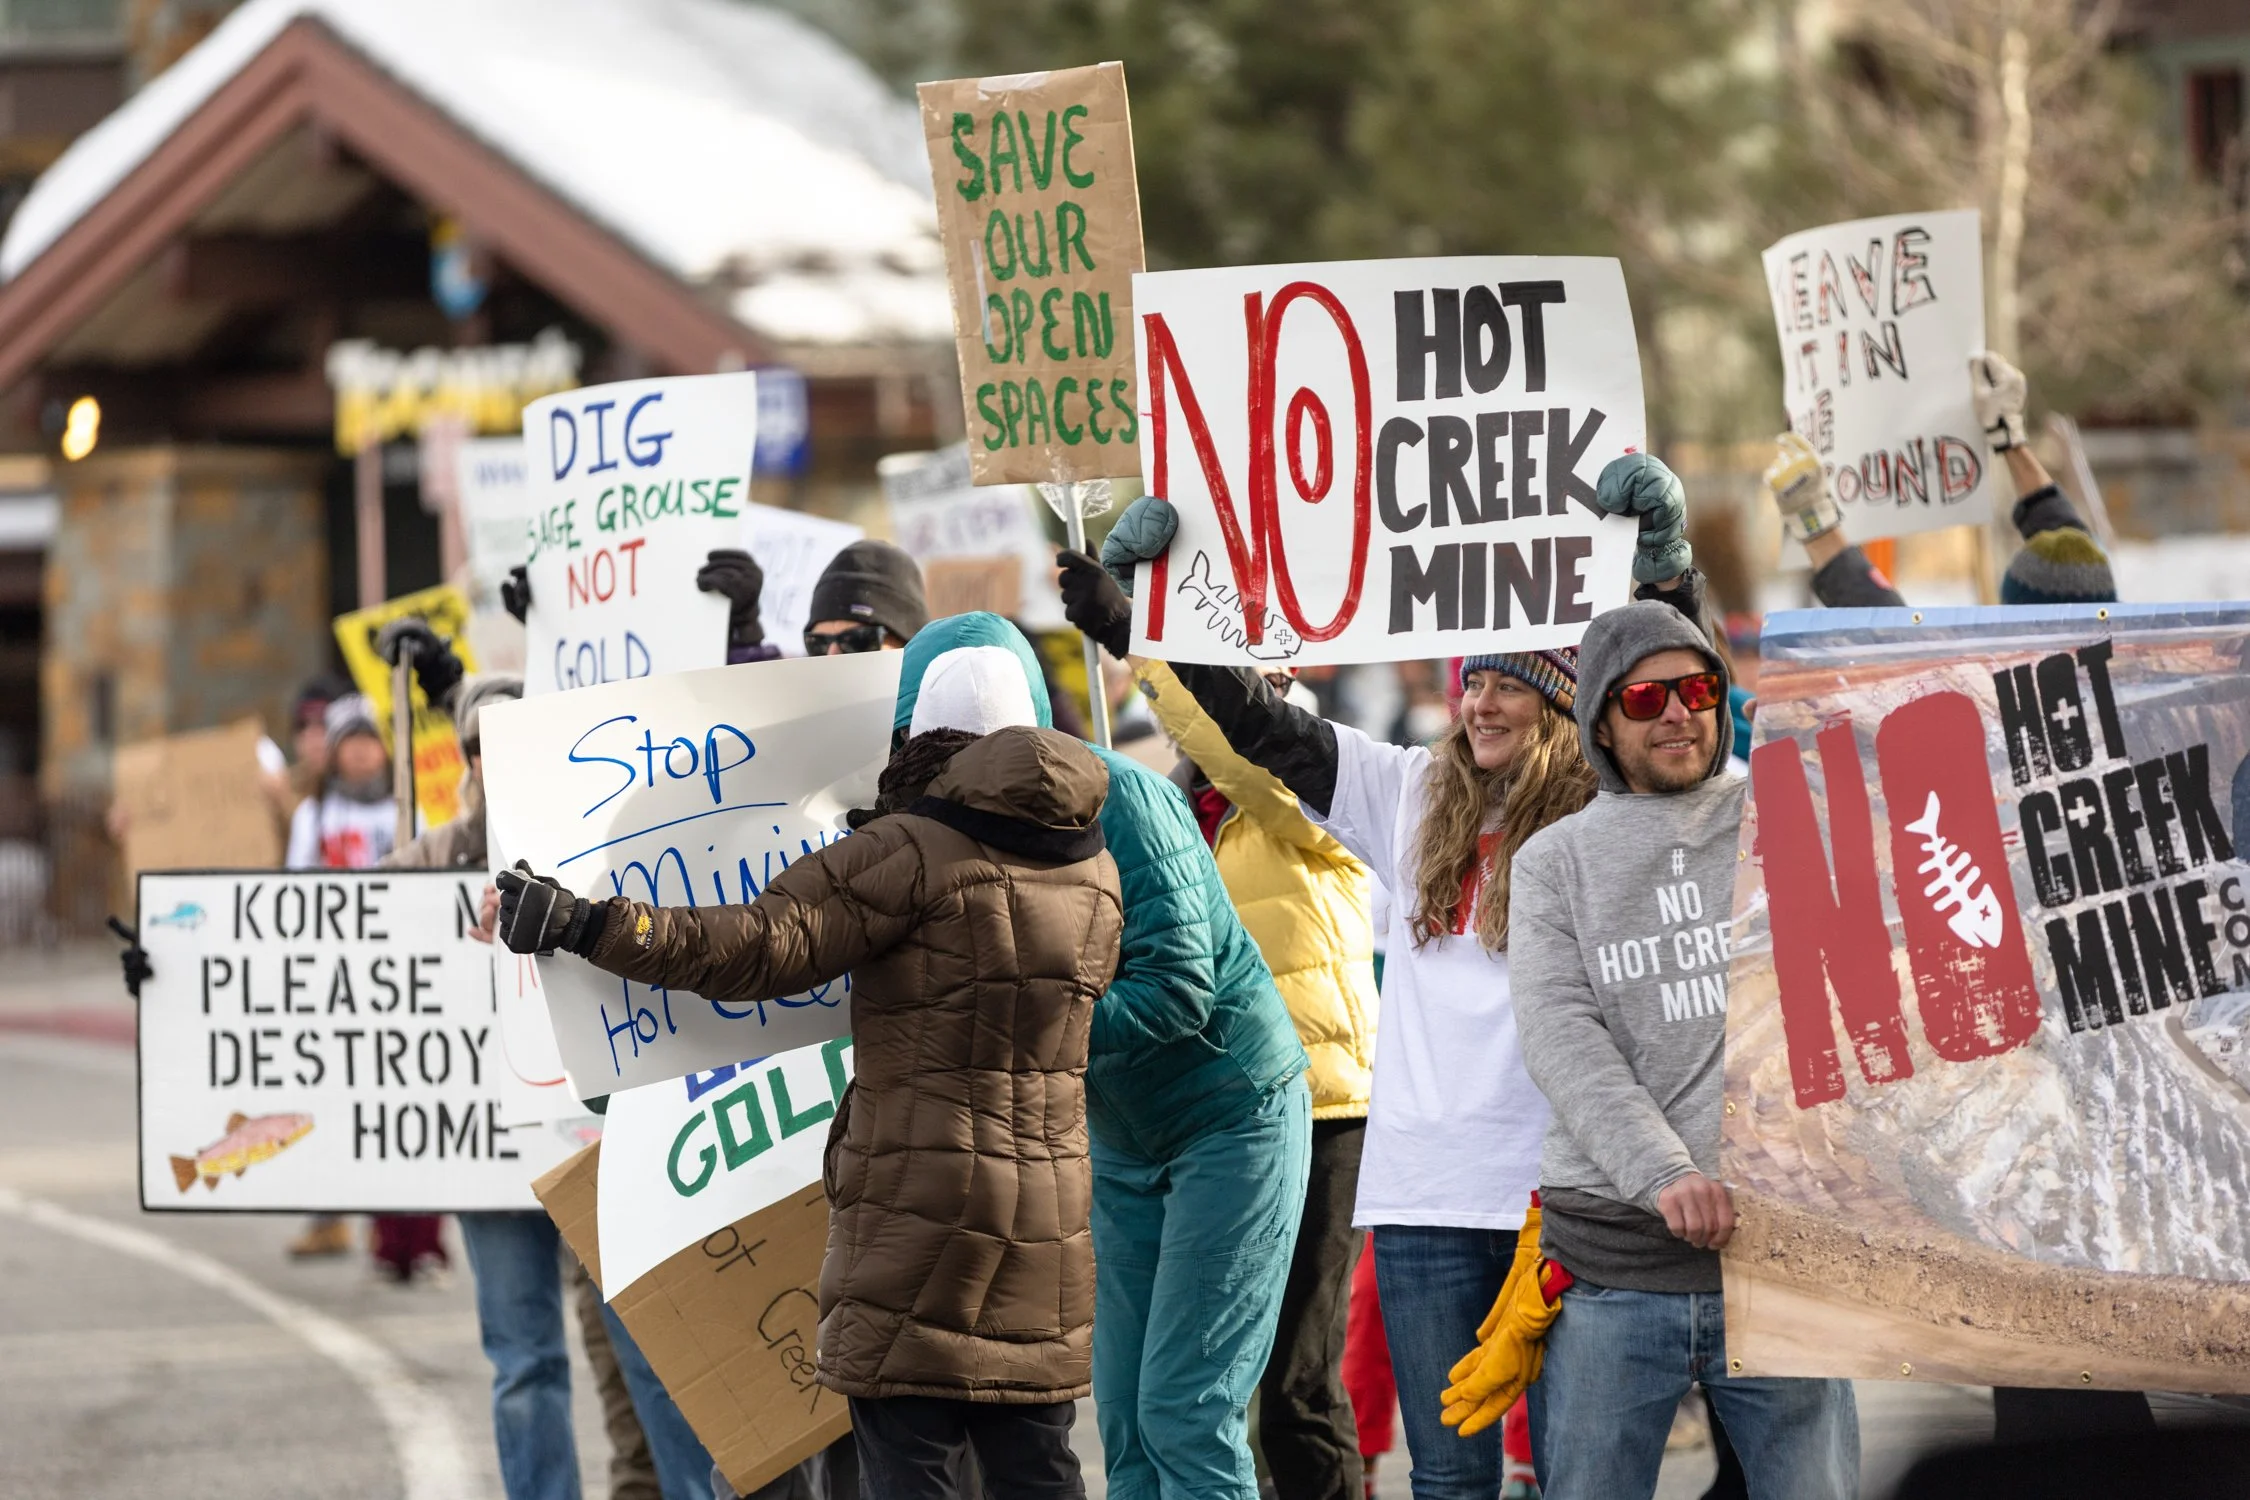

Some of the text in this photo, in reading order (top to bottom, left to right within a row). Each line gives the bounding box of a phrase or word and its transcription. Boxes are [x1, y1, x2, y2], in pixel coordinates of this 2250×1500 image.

[952, 104, 1095, 202] SAVE
[984, 201, 1096, 281] OUR
[984, 287, 1115, 365] OPEN
[1394, 280, 1566, 402] HOT
[1837, 320, 1909, 387] IN
[550, 392, 673, 481] DIG
[976, 376, 1138, 451] SPACES
[1143, 281, 1371, 644] NO
[1375, 407, 1607, 533] CREEK
[527, 500, 582, 564] SAGE
[597, 477, 741, 534] GROUSE
[567, 537, 646, 610] NOT
[1387, 536, 1592, 634] MINE
[555, 631, 651, 691] GOLD
[1993, 635, 2127, 787] HOT
[568, 716, 756, 818] Stop
[2019, 743, 2236, 908] CREEK
[234, 882, 390, 940] KORE
[1656, 881, 1702, 925] NO
[1751, 690, 2043, 1109] NO
[201, 957, 443, 1015] PLEASE
[1598, 936, 1661, 984] HOT
[2045, 879, 2229, 1034] MINE
[209, 1027, 490, 1088] DESTROY
[354, 1101, 519, 1160] HOME
